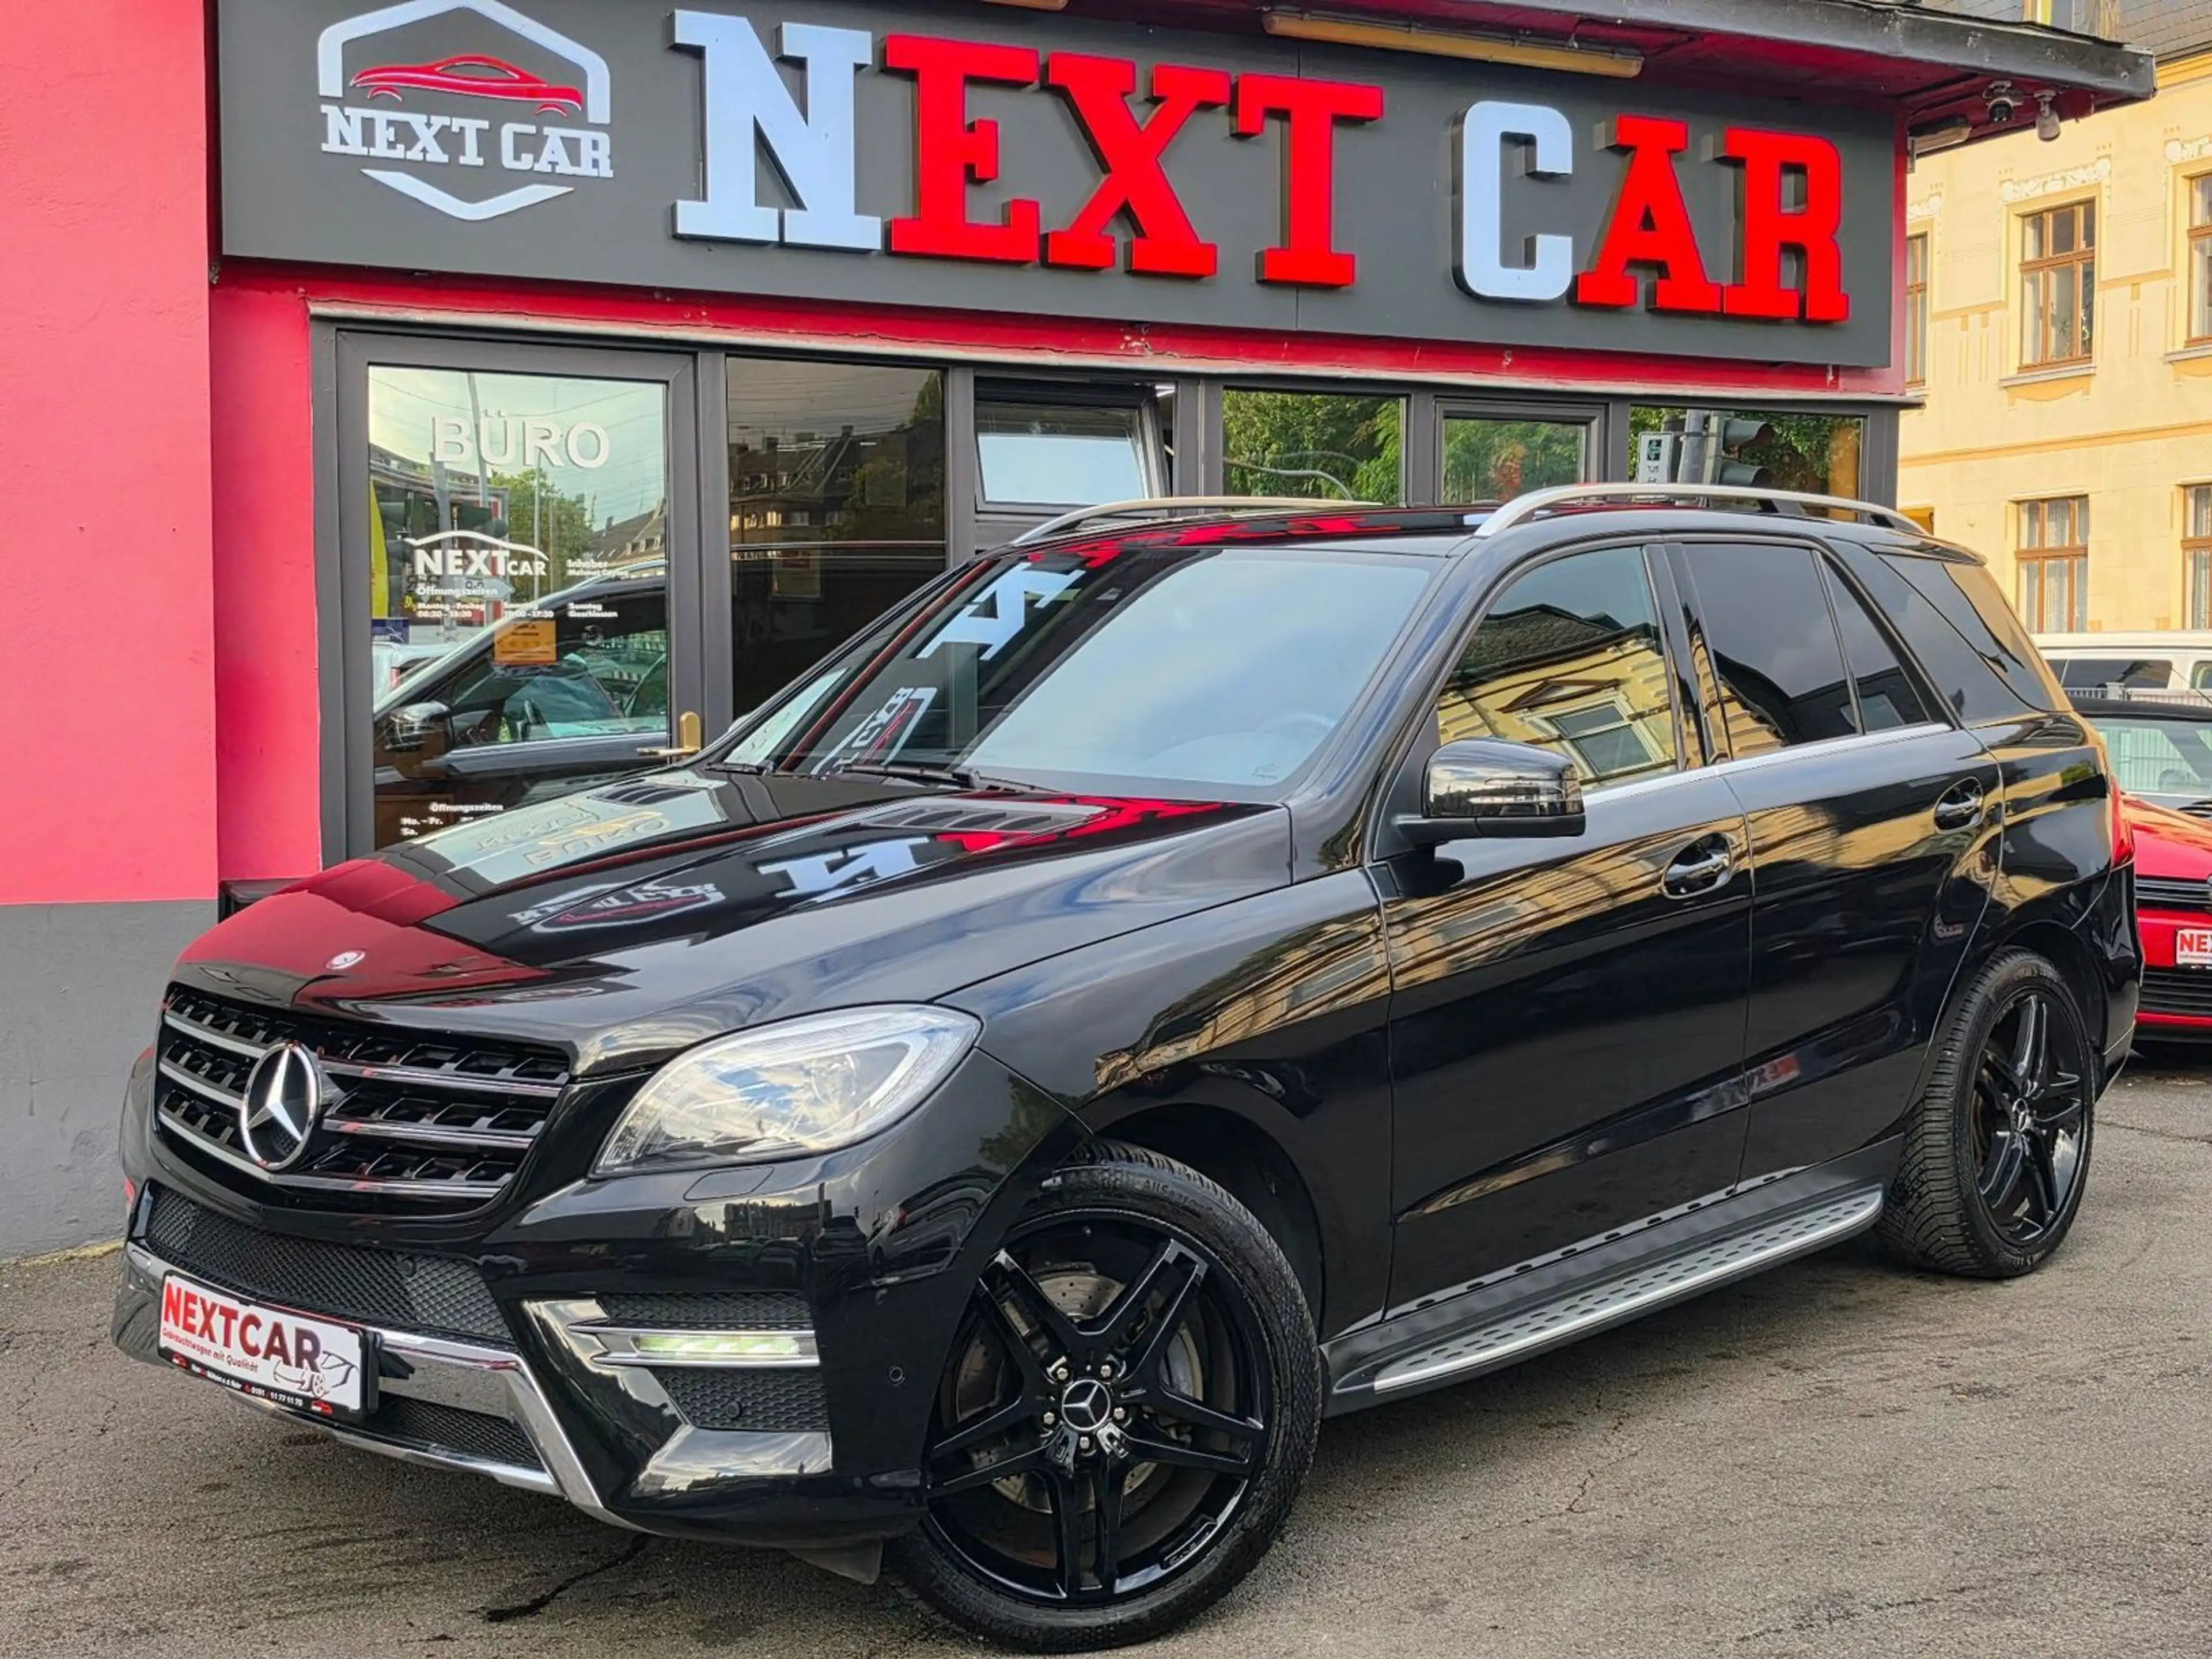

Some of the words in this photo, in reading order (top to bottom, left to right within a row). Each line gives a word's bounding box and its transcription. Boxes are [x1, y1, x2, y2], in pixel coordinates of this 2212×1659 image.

[321, 104, 489, 167] NEXT
[500, 122, 614, 178] CAR
[672, 9, 1384, 288] NEXT
[1455, 99, 1850, 323] CAR
[431, 408, 609, 469] BÜRO
[163, 1282, 321, 1373] NEXTCAR
